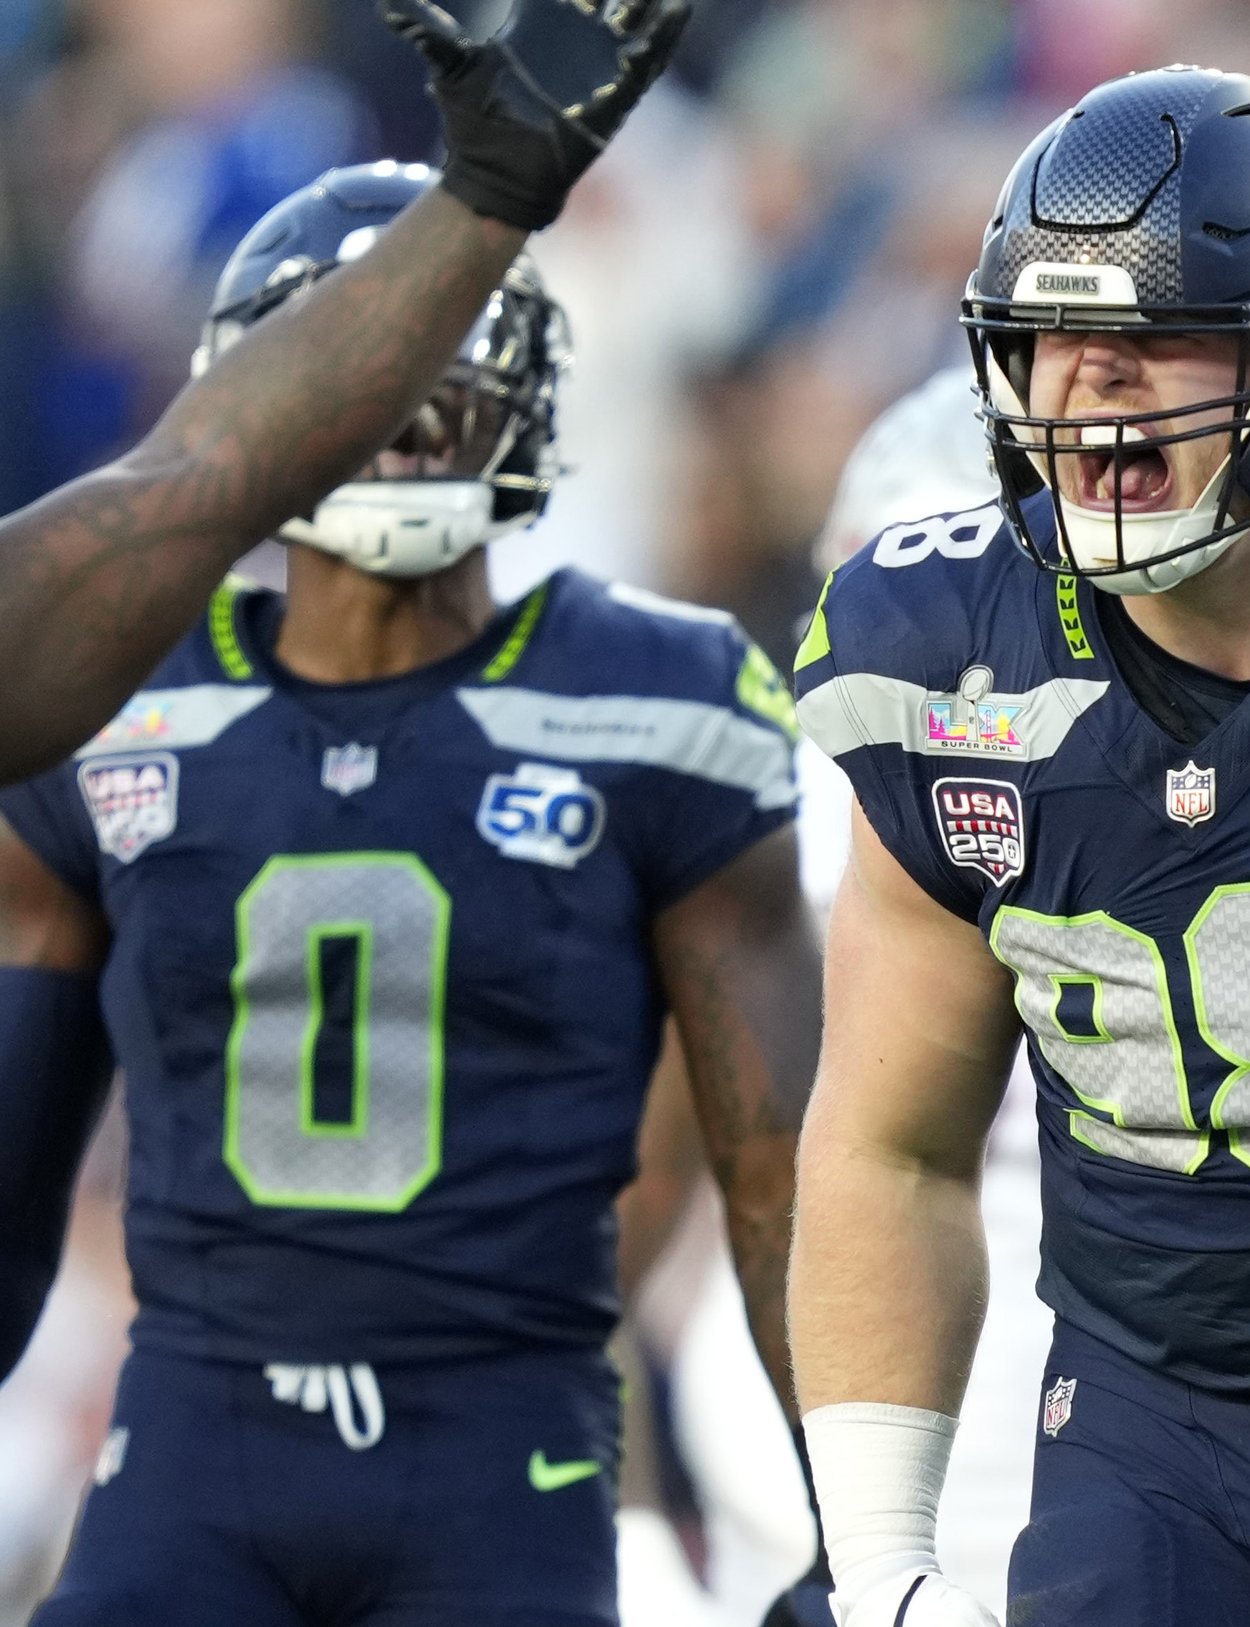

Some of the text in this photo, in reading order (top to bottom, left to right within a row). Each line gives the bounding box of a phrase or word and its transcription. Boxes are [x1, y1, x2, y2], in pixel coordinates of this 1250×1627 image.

[1036, 273, 1099, 293] SEAHAWKS
[941, 740, 1013, 753] SUPER BOWL
[489, 786, 596, 848] 50
[943, 792, 1015, 821] USA
[1175, 792, 1208, 816] NFL
[950, 833, 1020, 867] 250
[223, 852, 452, 1213] 0
